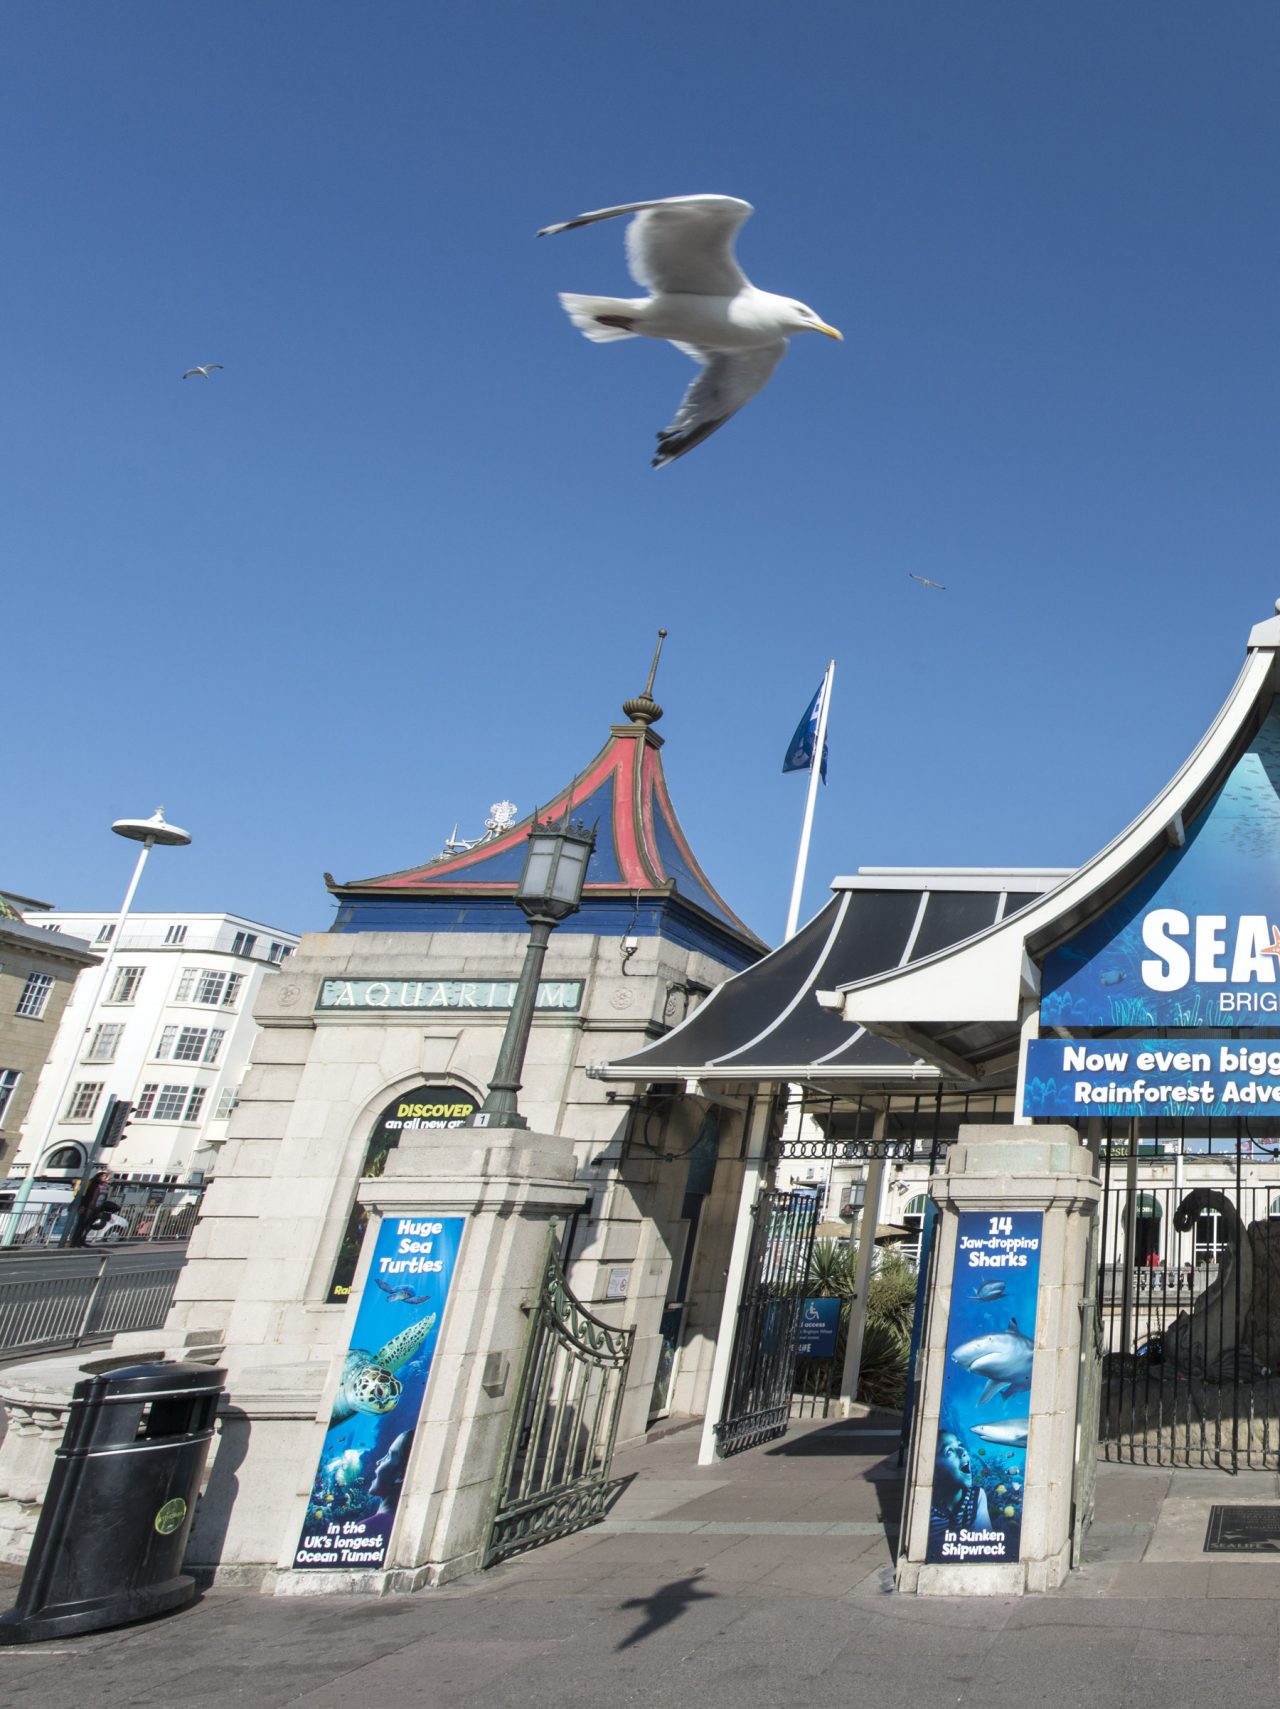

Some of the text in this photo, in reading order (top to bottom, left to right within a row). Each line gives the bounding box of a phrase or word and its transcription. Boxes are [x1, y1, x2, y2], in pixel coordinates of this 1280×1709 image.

[333, 981, 565, 1008] AQUARIM
[1062, 1046, 1129, 1073] Now
[1136, 1050, 1211, 1073] even
[1074, 1079, 1215, 1105] Rainforest
[397, 1103, 473, 1118] DISCOVER
[385, 1119, 402, 1129] an
[403, 1117, 420, 1130] all
[420, 1120, 447, 1129] new
[480, 1115, 486, 1124] 1
[397, 1219, 443, 1237] Huge
[988, 1216, 1013, 1236] 14
[398, 1238, 433, 1254] Sea
[959, 1236, 1040, 1252] Jaw-dropping
[379, 1257, 443, 1273] Turtles
[968, 1251, 1028, 1267] Sharks
[327, 1521, 366, 1535] in the
[944, 1528, 1005, 1542] in Sunken
[304, 1534, 383, 1550] UK's longest
[296, 1548, 385, 1562] Ocean Tunnel
[941, 1542, 1006, 1560] Shipwreck
